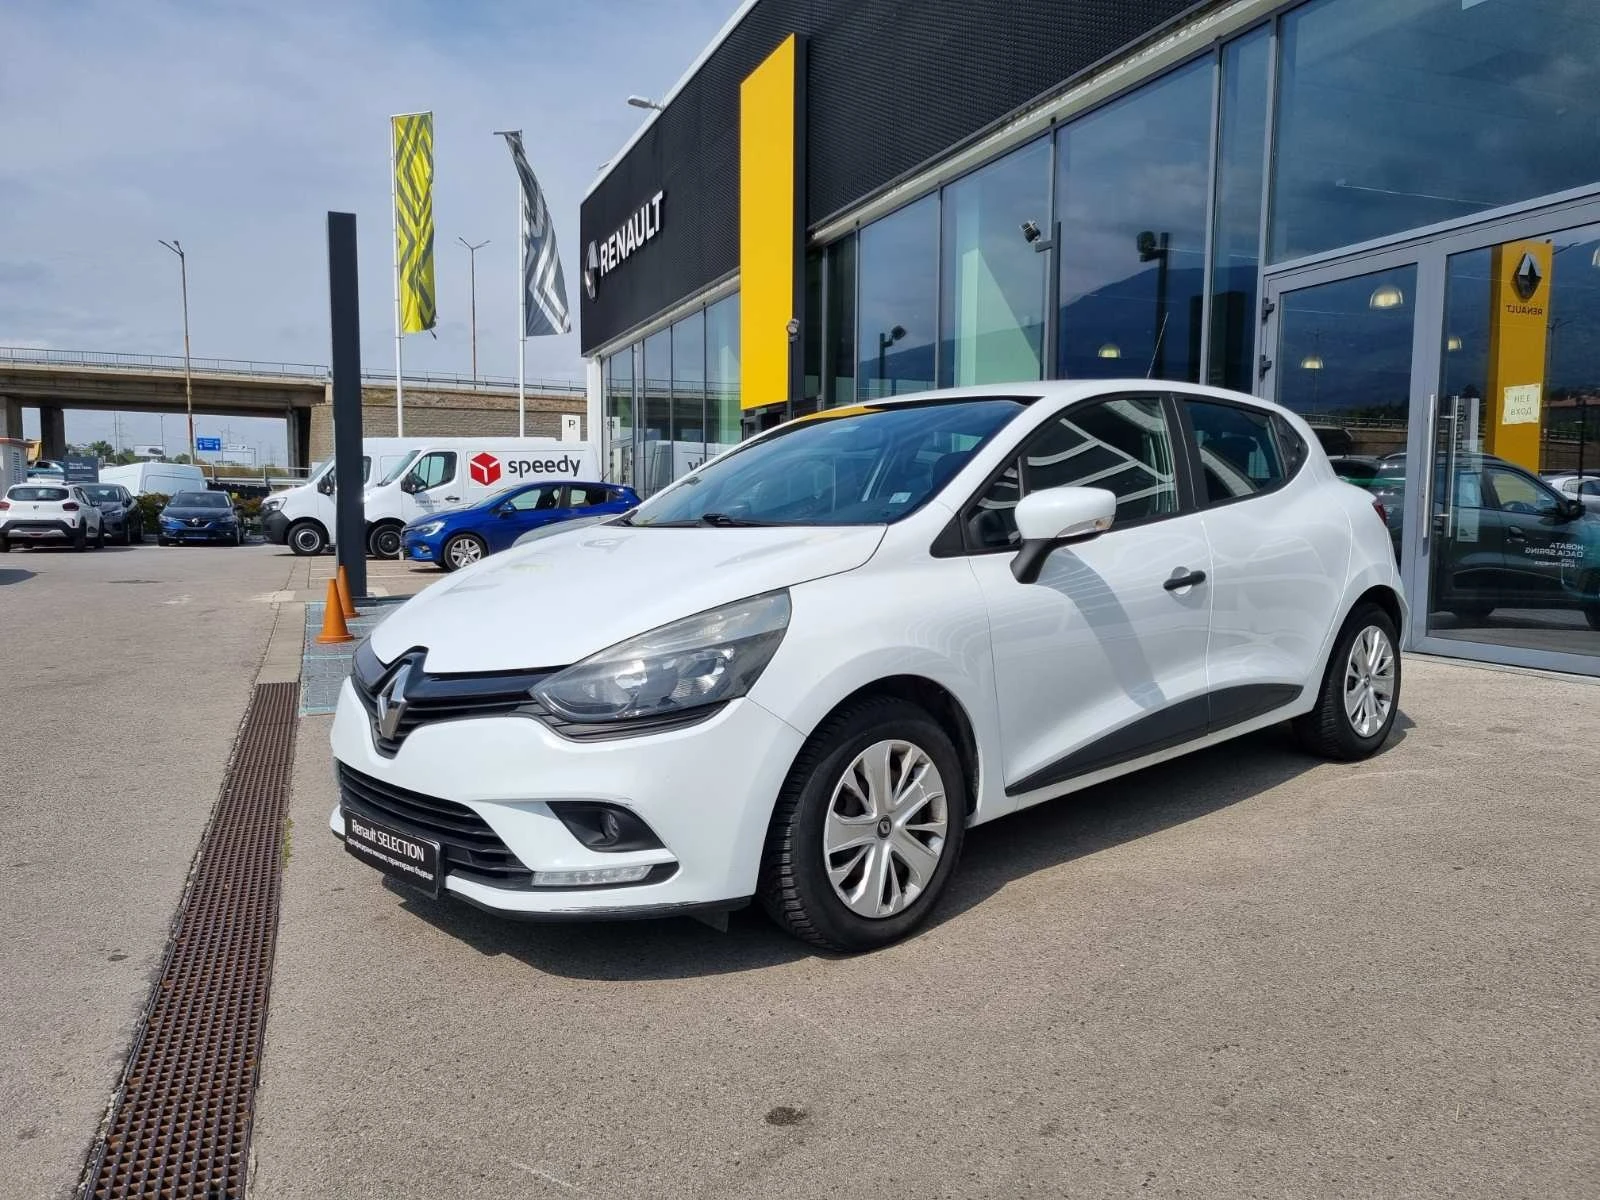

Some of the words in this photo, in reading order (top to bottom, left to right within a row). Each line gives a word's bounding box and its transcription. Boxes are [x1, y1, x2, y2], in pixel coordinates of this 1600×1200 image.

[600, 190, 663, 277] RENAULT
[568, 419, 576, 429] P
[508, 455, 581, 478] speedy
[352, 819, 377, 843] Renault
[377, 831, 425, 862] SELECTION
